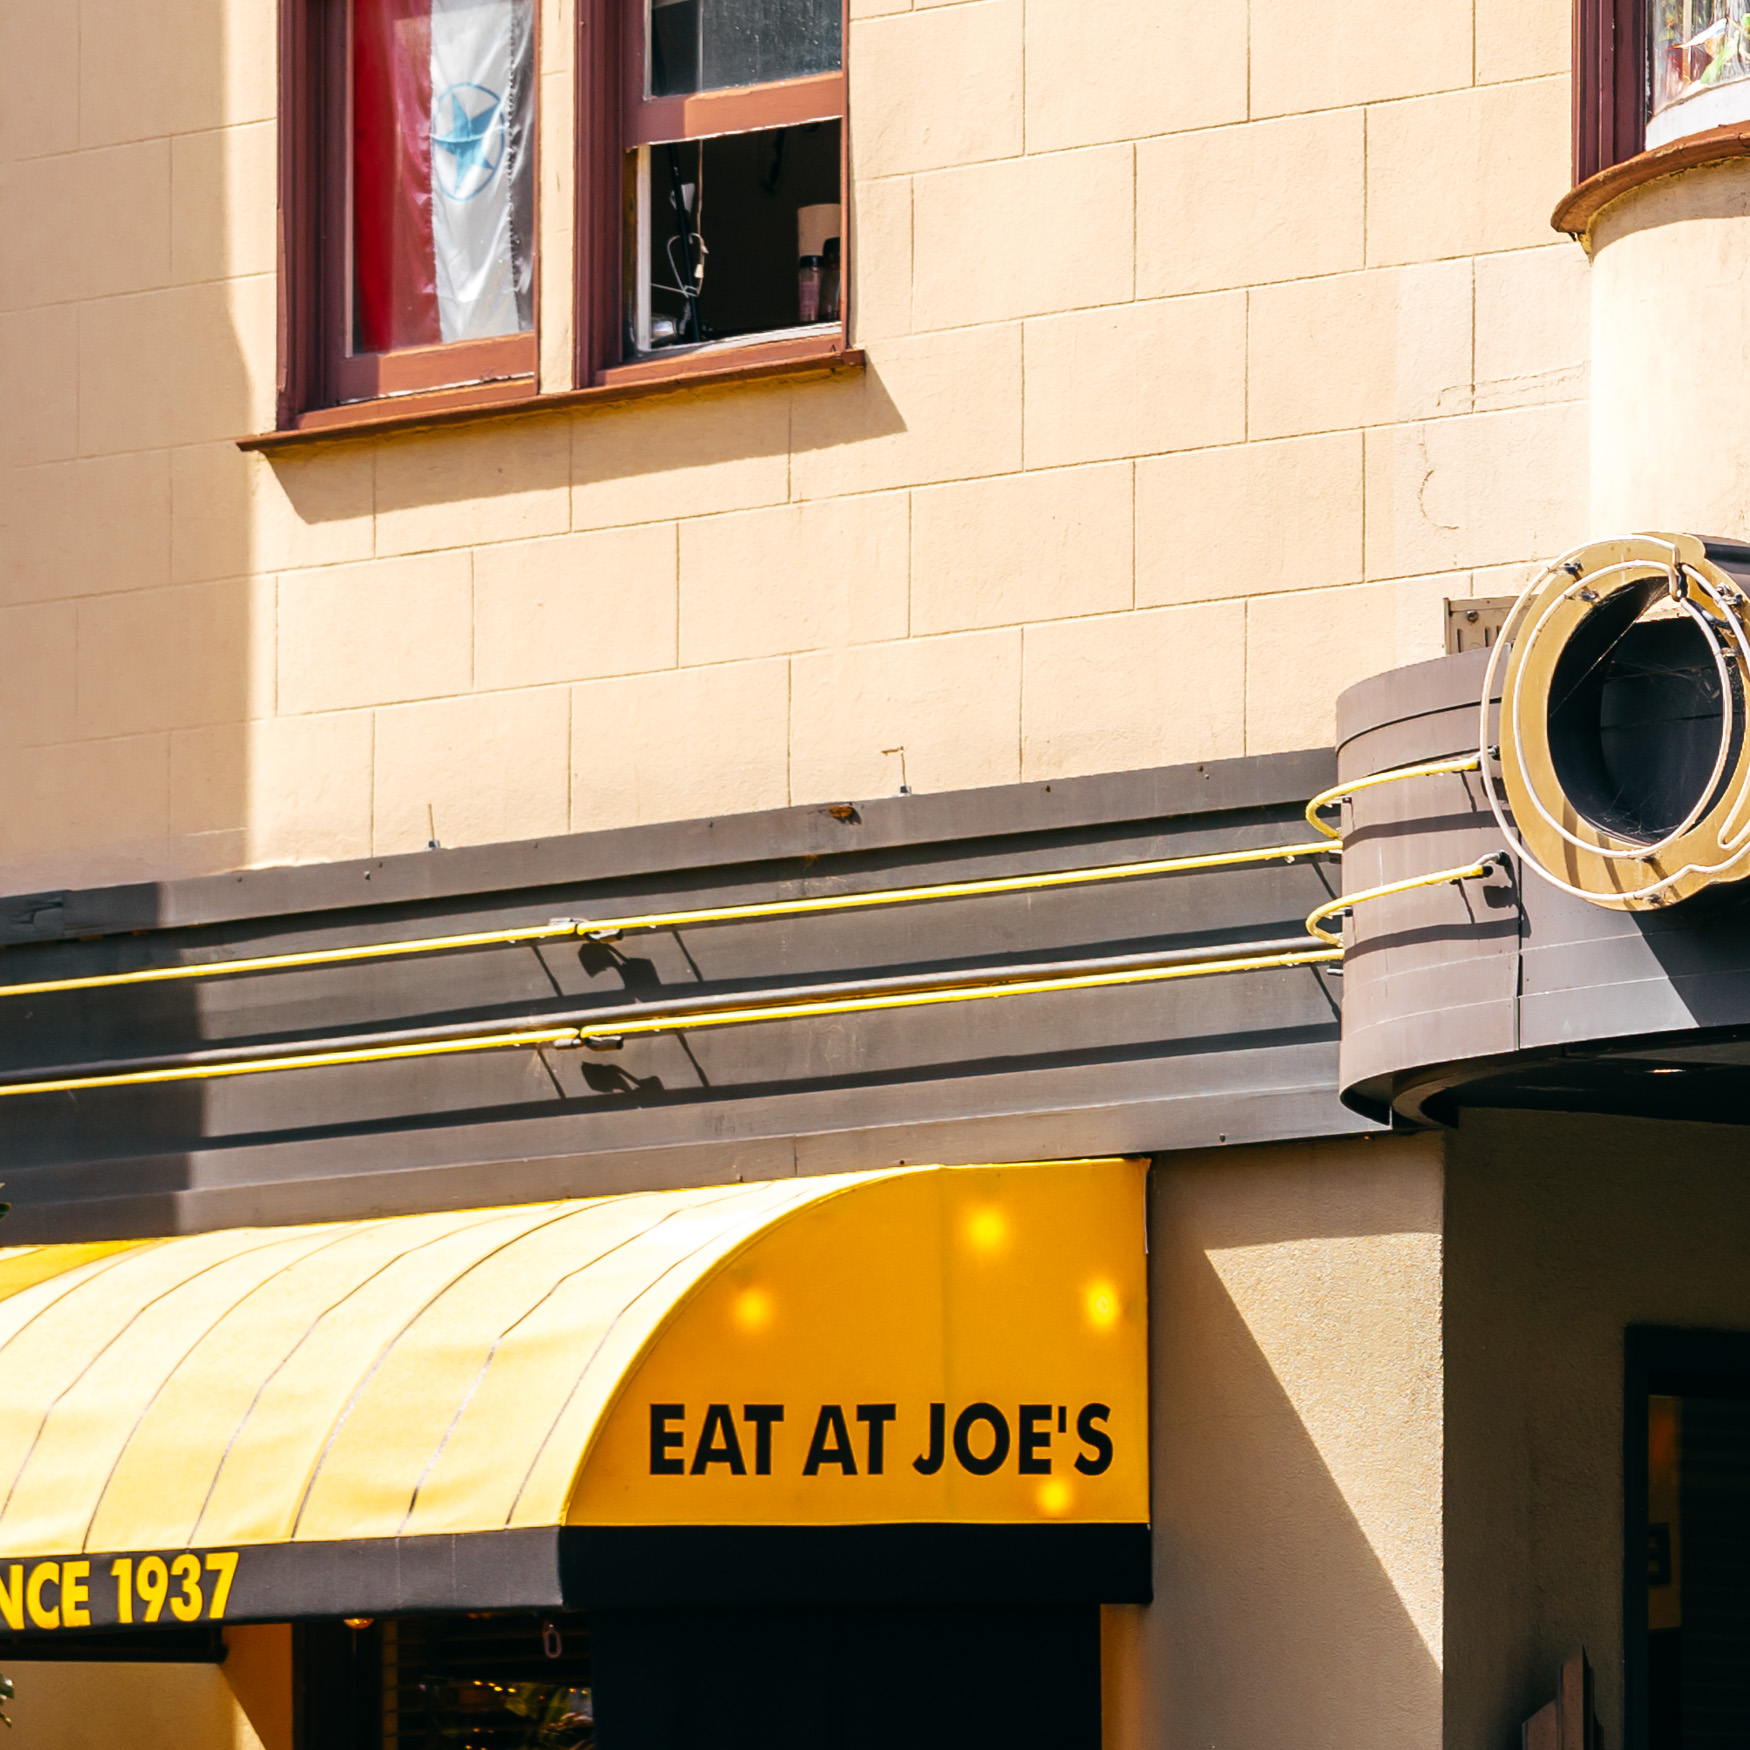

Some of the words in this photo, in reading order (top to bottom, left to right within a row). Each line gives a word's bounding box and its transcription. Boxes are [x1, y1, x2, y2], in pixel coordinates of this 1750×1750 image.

[648, 1403, 785, 1476] EAT
[801, 1402, 897, 1476] AT
[911, 1401, 1115, 1476] JOE'S
[110, 1551, 240, 1624] 1937
